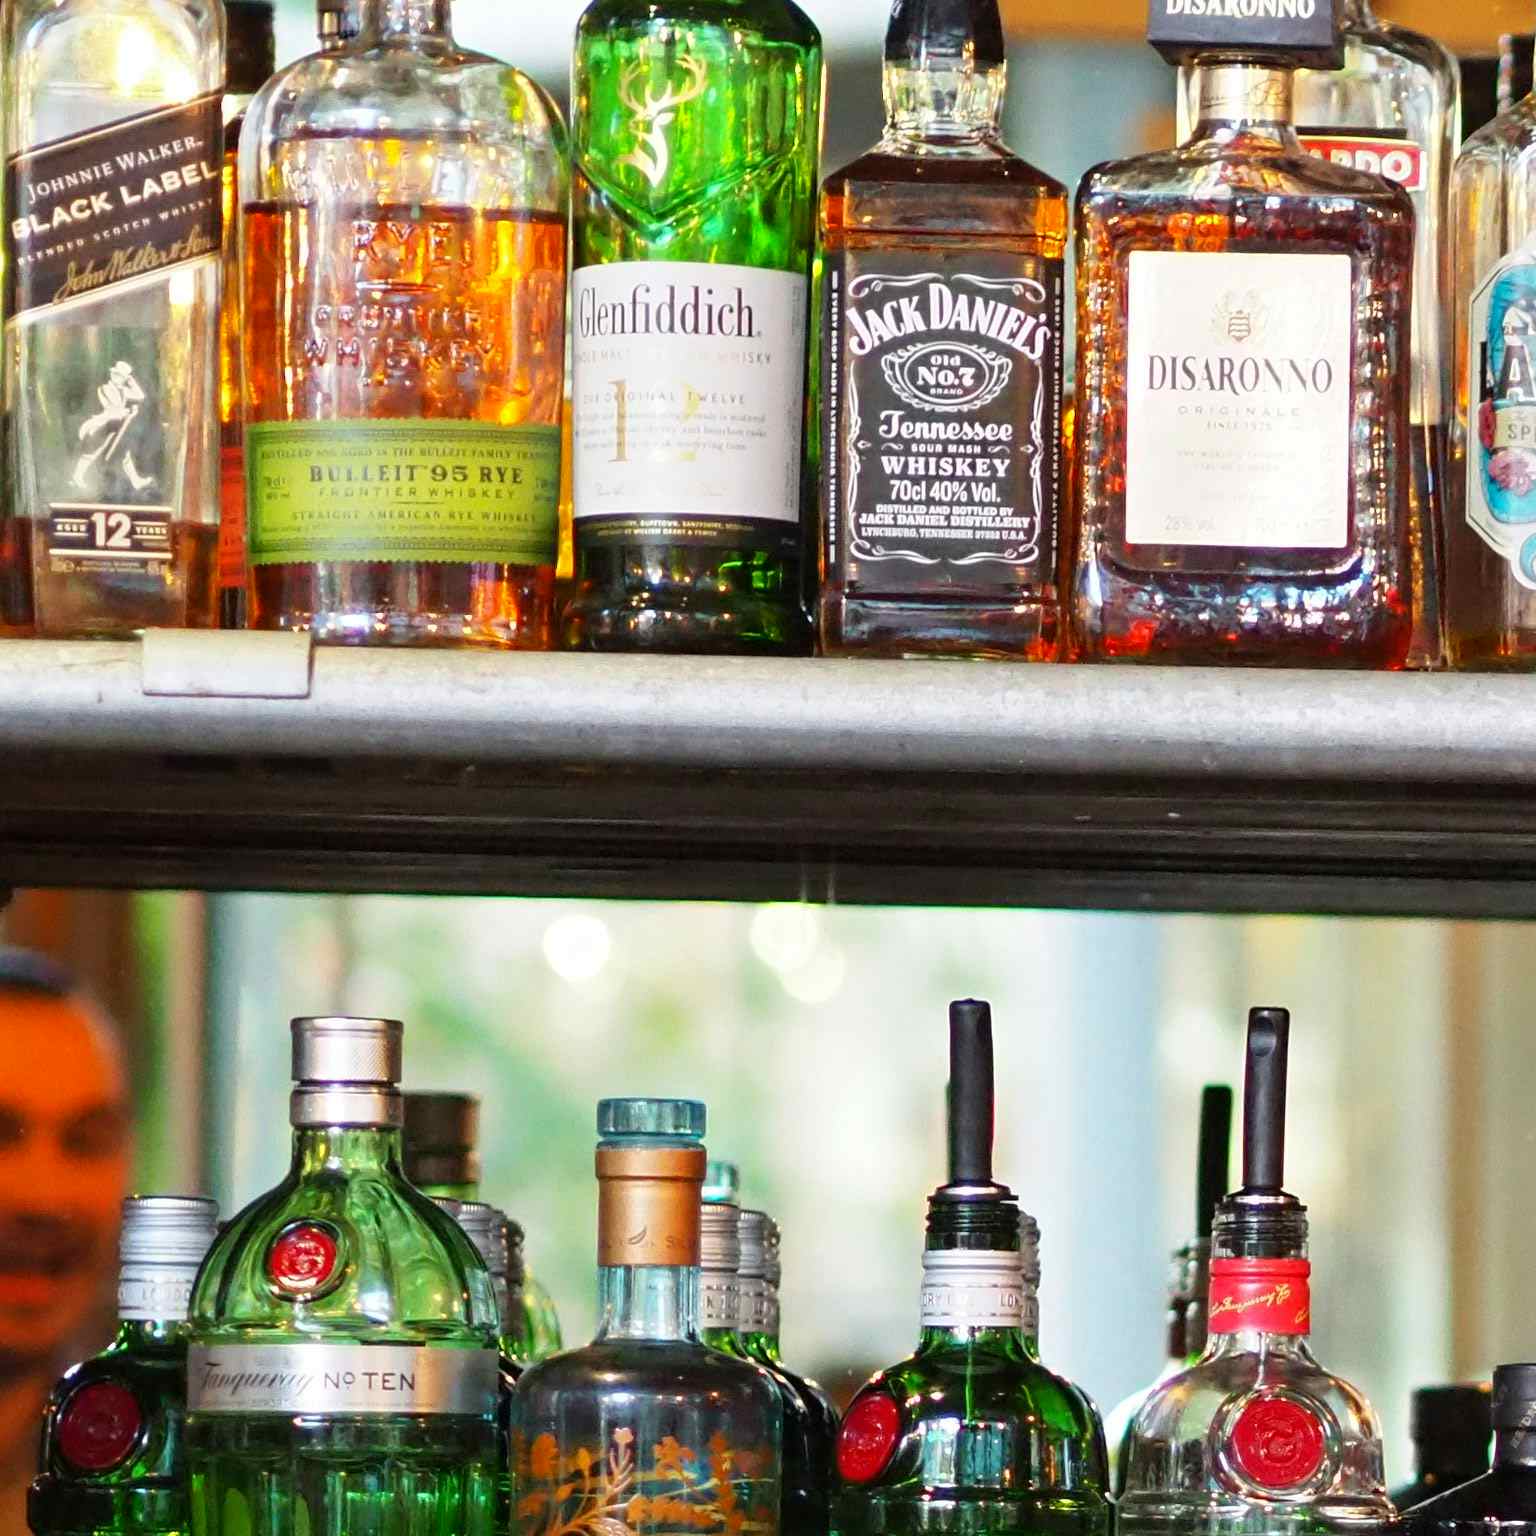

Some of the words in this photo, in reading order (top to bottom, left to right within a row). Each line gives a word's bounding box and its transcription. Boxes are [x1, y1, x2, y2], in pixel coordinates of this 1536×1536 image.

[27, 162, 114, 205] JOHNNIE
[116, 136, 202, 171] WALKER
[12, 191, 114, 240] BLACK
[119, 160, 219, 206] LABEL
[94, 217, 150, 241] SCOTCH
[579, 283, 757, 339] Glenfiddich
[845, 294, 929, 356] JACK
[928, 283, 1052, 361] DANIEL'S
[930, 353, 961, 367] Old
[916, 365, 977, 387] No.7
[1147, 354, 1334, 396] DISARONNO
[688, 390, 746, 405] TWELVE
[929, 387, 964, 396] BRAND
[1176, 405, 1301, 418] ORIGINALE
[878, 410, 1013, 442] Tennessee
[911, 443, 943, 453] SOUR
[948, 444, 982, 454] MASH
[310, 464, 418, 483] BULLEIT
[430, 464, 470, 483] 95
[479, 466, 525, 485] RYE
[880, 455, 1011, 478] WHISKEY
[318, 486, 418, 498] FRONTIER
[429, 487, 517, 499] WHISKEY
[889, 479, 926, 501] 70cl
[929, 480, 968, 502] 40%
[971, 480, 1001, 503] Vol.
[292, 509, 361, 522] STRAIGHT
[367, 509, 441, 521] AMERICAN
[448, 510, 474, 521] RYE
[859, 512, 895, 525] JACK
[896, 513, 949, 526] DANIEL
[949, 516, 1032, 529] DISTILLERY
[876, 504, 927, 514] DISTILLED
[928, 505, 950, 515] AND
[952, 505, 997, 516] BOTTLED
[999, 506, 1014, 516] BY
[91, 512, 132, 548] 12
[918, 528, 974, 539] TENNESSEE
[200, 1361, 315, 1397] Tanqueray
[361, 1371, 418, 1392] TEN
